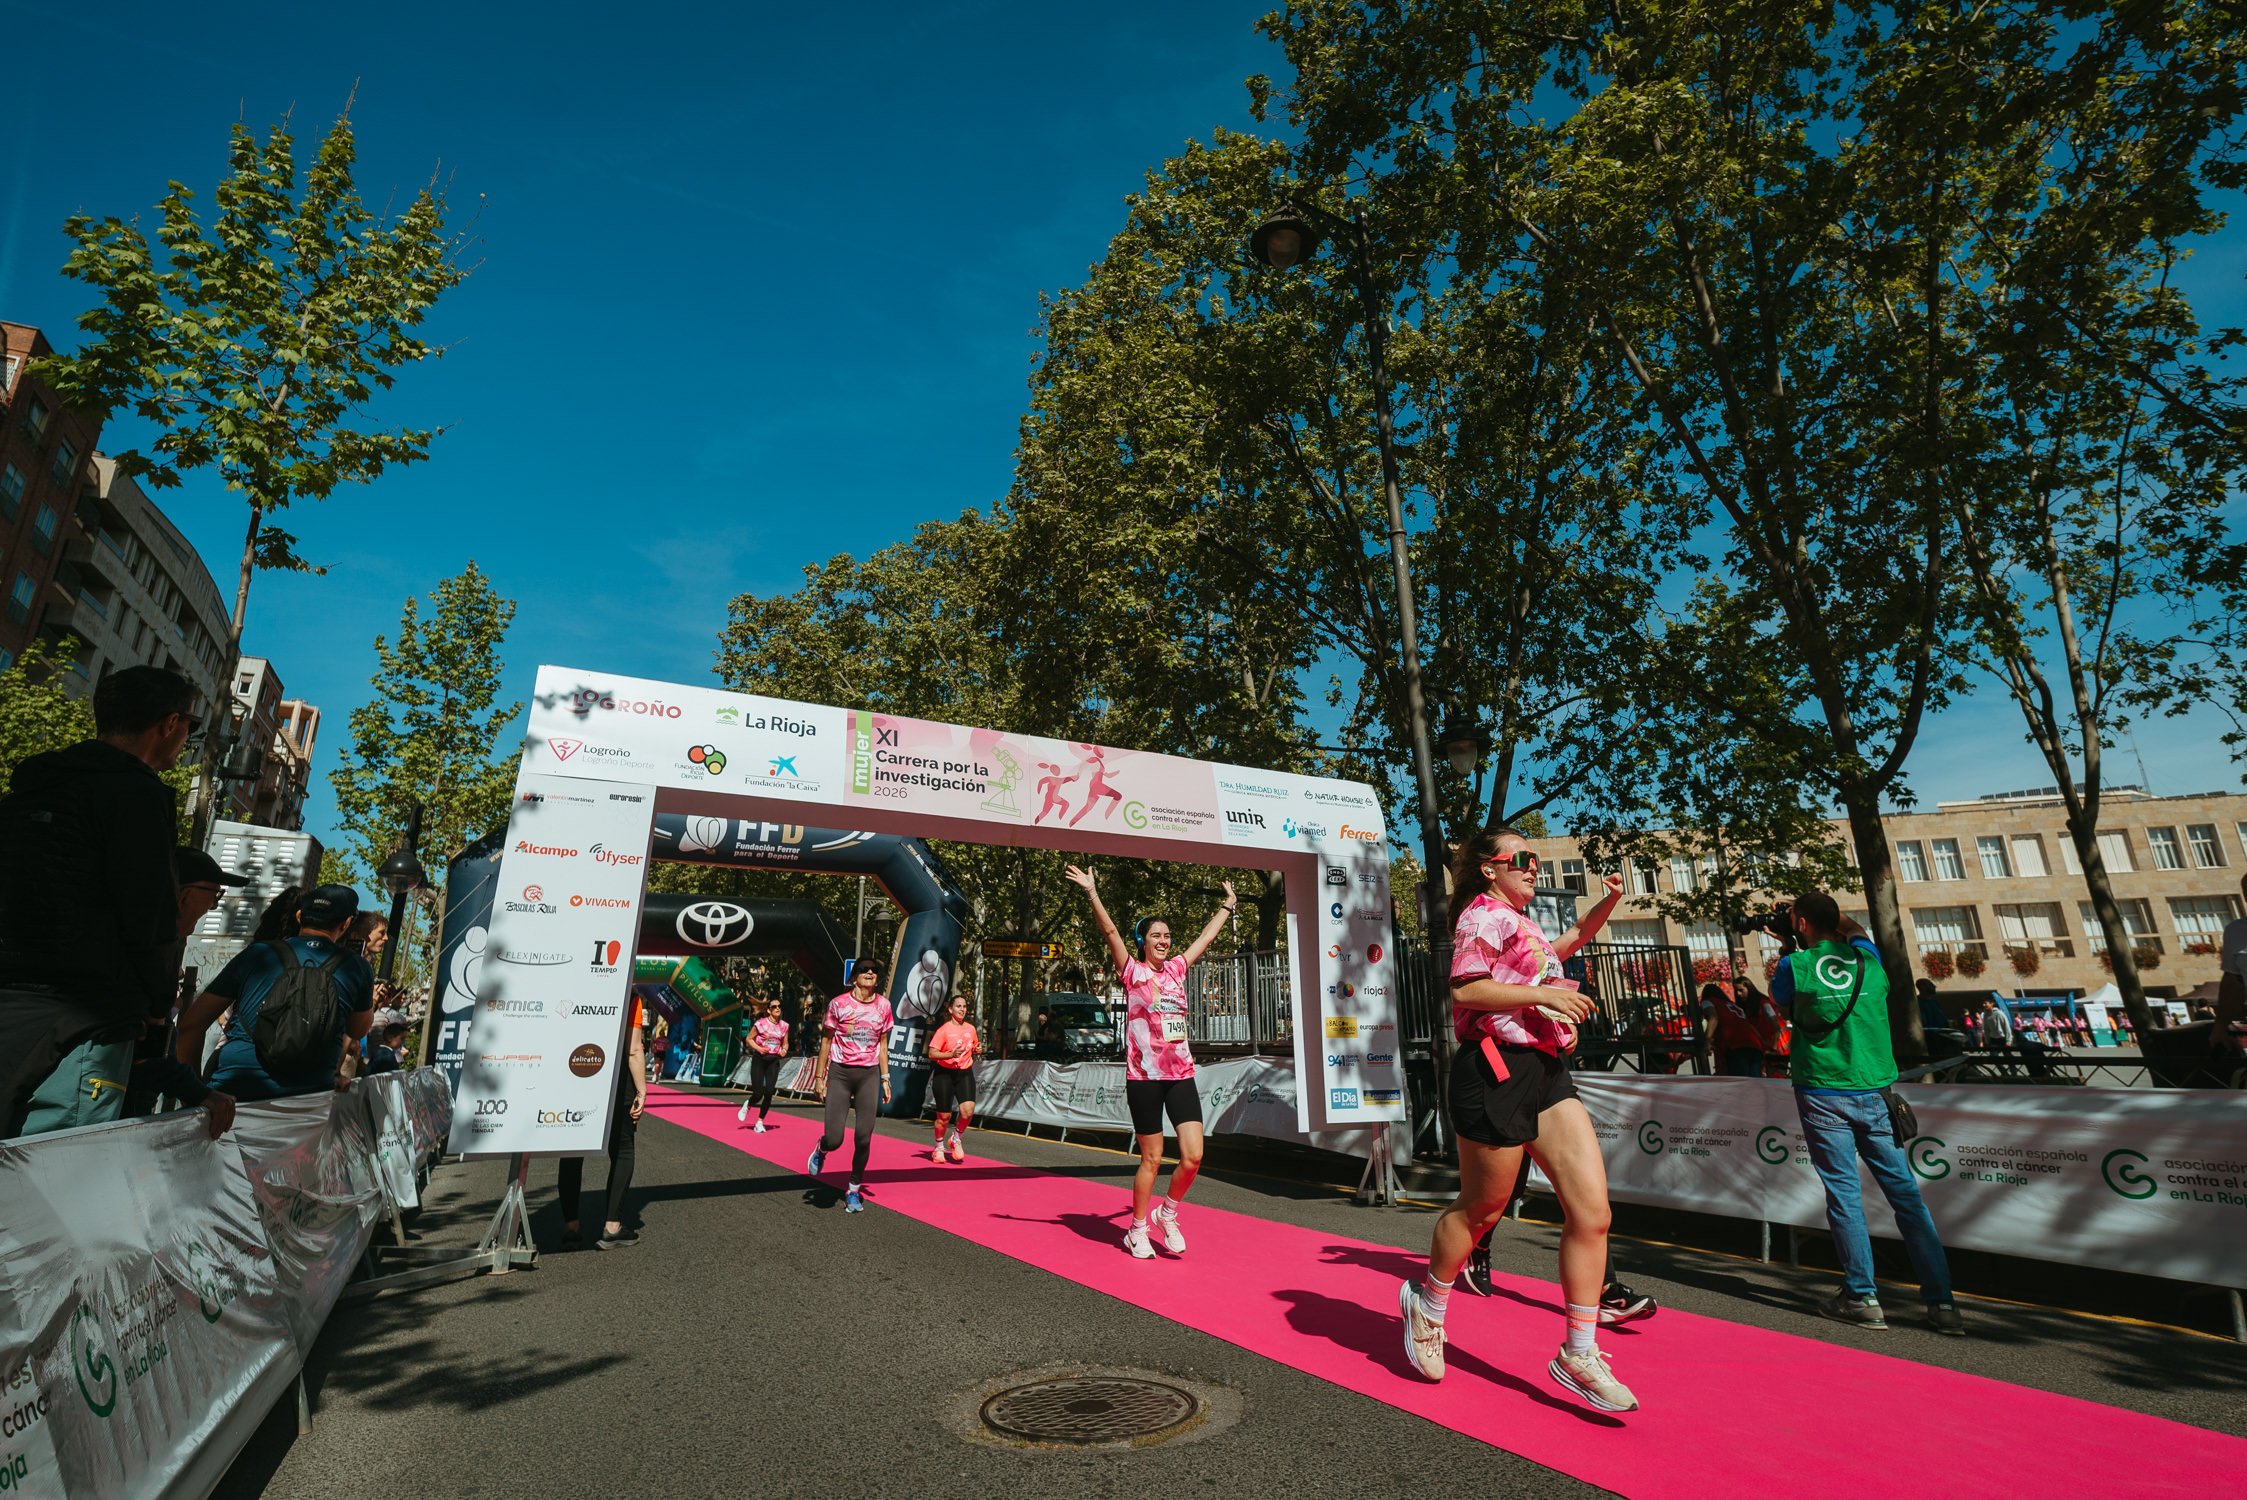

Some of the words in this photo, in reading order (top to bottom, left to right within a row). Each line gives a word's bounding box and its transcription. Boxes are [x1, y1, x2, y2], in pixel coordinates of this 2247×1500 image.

[572, 689, 682, 719] LOGROÑO
[745, 712, 766, 730] La
[770, 715, 817, 738] Rioja
[876, 728, 899, 747] XI
[583, 744, 631, 758] Logroño
[854, 731, 872, 788] mujer
[875, 750, 939, 770] Carrera
[943, 761, 971, 775] por
[974, 763, 989, 776] la
[744, 777, 785, 788] Fundación
[875, 767, 986, 793] investigación
[874, 785, 908, 799] 2026
[1151, 806, 1184, 817] asociación
[1186, 808, 1215, 821] española
[1152, 814, 1172, 824] contra
[1174, 816, 1181, 824] el
[1182, 816, 1203, 826] cáncer
[1296, 825, 1327, 837] viamed
[515, 840, 578, 858] Alcampo
[735, 842, 775, 852] Fundación
[777, 845, 801, 854] Ferrer
[767, 852, 799, 860] Deporte
[585, 897, 630, 909] VIVAGYM
[680, 973, 714, 1012] PITILLOS
[1364, 986, 1388, 996] rioja2
[486, 999, 544, 1013] garnica
[572, 1005, 618, 1016] ARNAUT
[1167, 1022, 1185, 1033] 7498
[437, 1020, 472, 1050] FF
[435, 1052, 465, 1060] Fundaci
[1328, 1055, 1346, 1067] 941
[1366, 1053, 1393, 1062] Gente
[1332, 1091, 1340, 1103] El
[1341, 1092, 1357, 1103] Día
[474, 1099, 508, 1115] 100
[537, 1109, 585, 1124] tacto
[1602, 1122, 1633, 1131] española
[1669, 1125, 1710, 1135] asociación
[1711, 1127, 1749, 1137] española
[1669, 1136, 1694, 1145] contra
[1695, 1137, 1703, 1145] el
[1704, 1137, 1732, 1147] cáncer
[1680, 1147, 1690, 1155] La
[1691, 1147, 1711, 1158] Rioja
[1957, 1143, 2023, 1159] asociación
[2026, 1148, 2088, 1166] española
[1795, 1156, 1808, 1165] en
[1958, 1156, 1999, 1172] contra
[2002, 1158, 2014, 1171] el
[2016, 1159, 2062, 1175] cáncer
[1959, 1171, 1975, 1181] en
[1977, 1170, 1993, 1183] La
[1996, 1172, 2028, 1187] Rioja
[2167, 1174, 2220, 1187] contra
[2223, 1176, 2239, 1189] el
[2170, 1189, 2190, 1201] en
[2193, 1189, 2213, 1203] La
[2217, 1191, 2247, 1209] Rioj
[2, 1390, 53, 1438] cánc
[0, 1453, 28, 1493] oja
